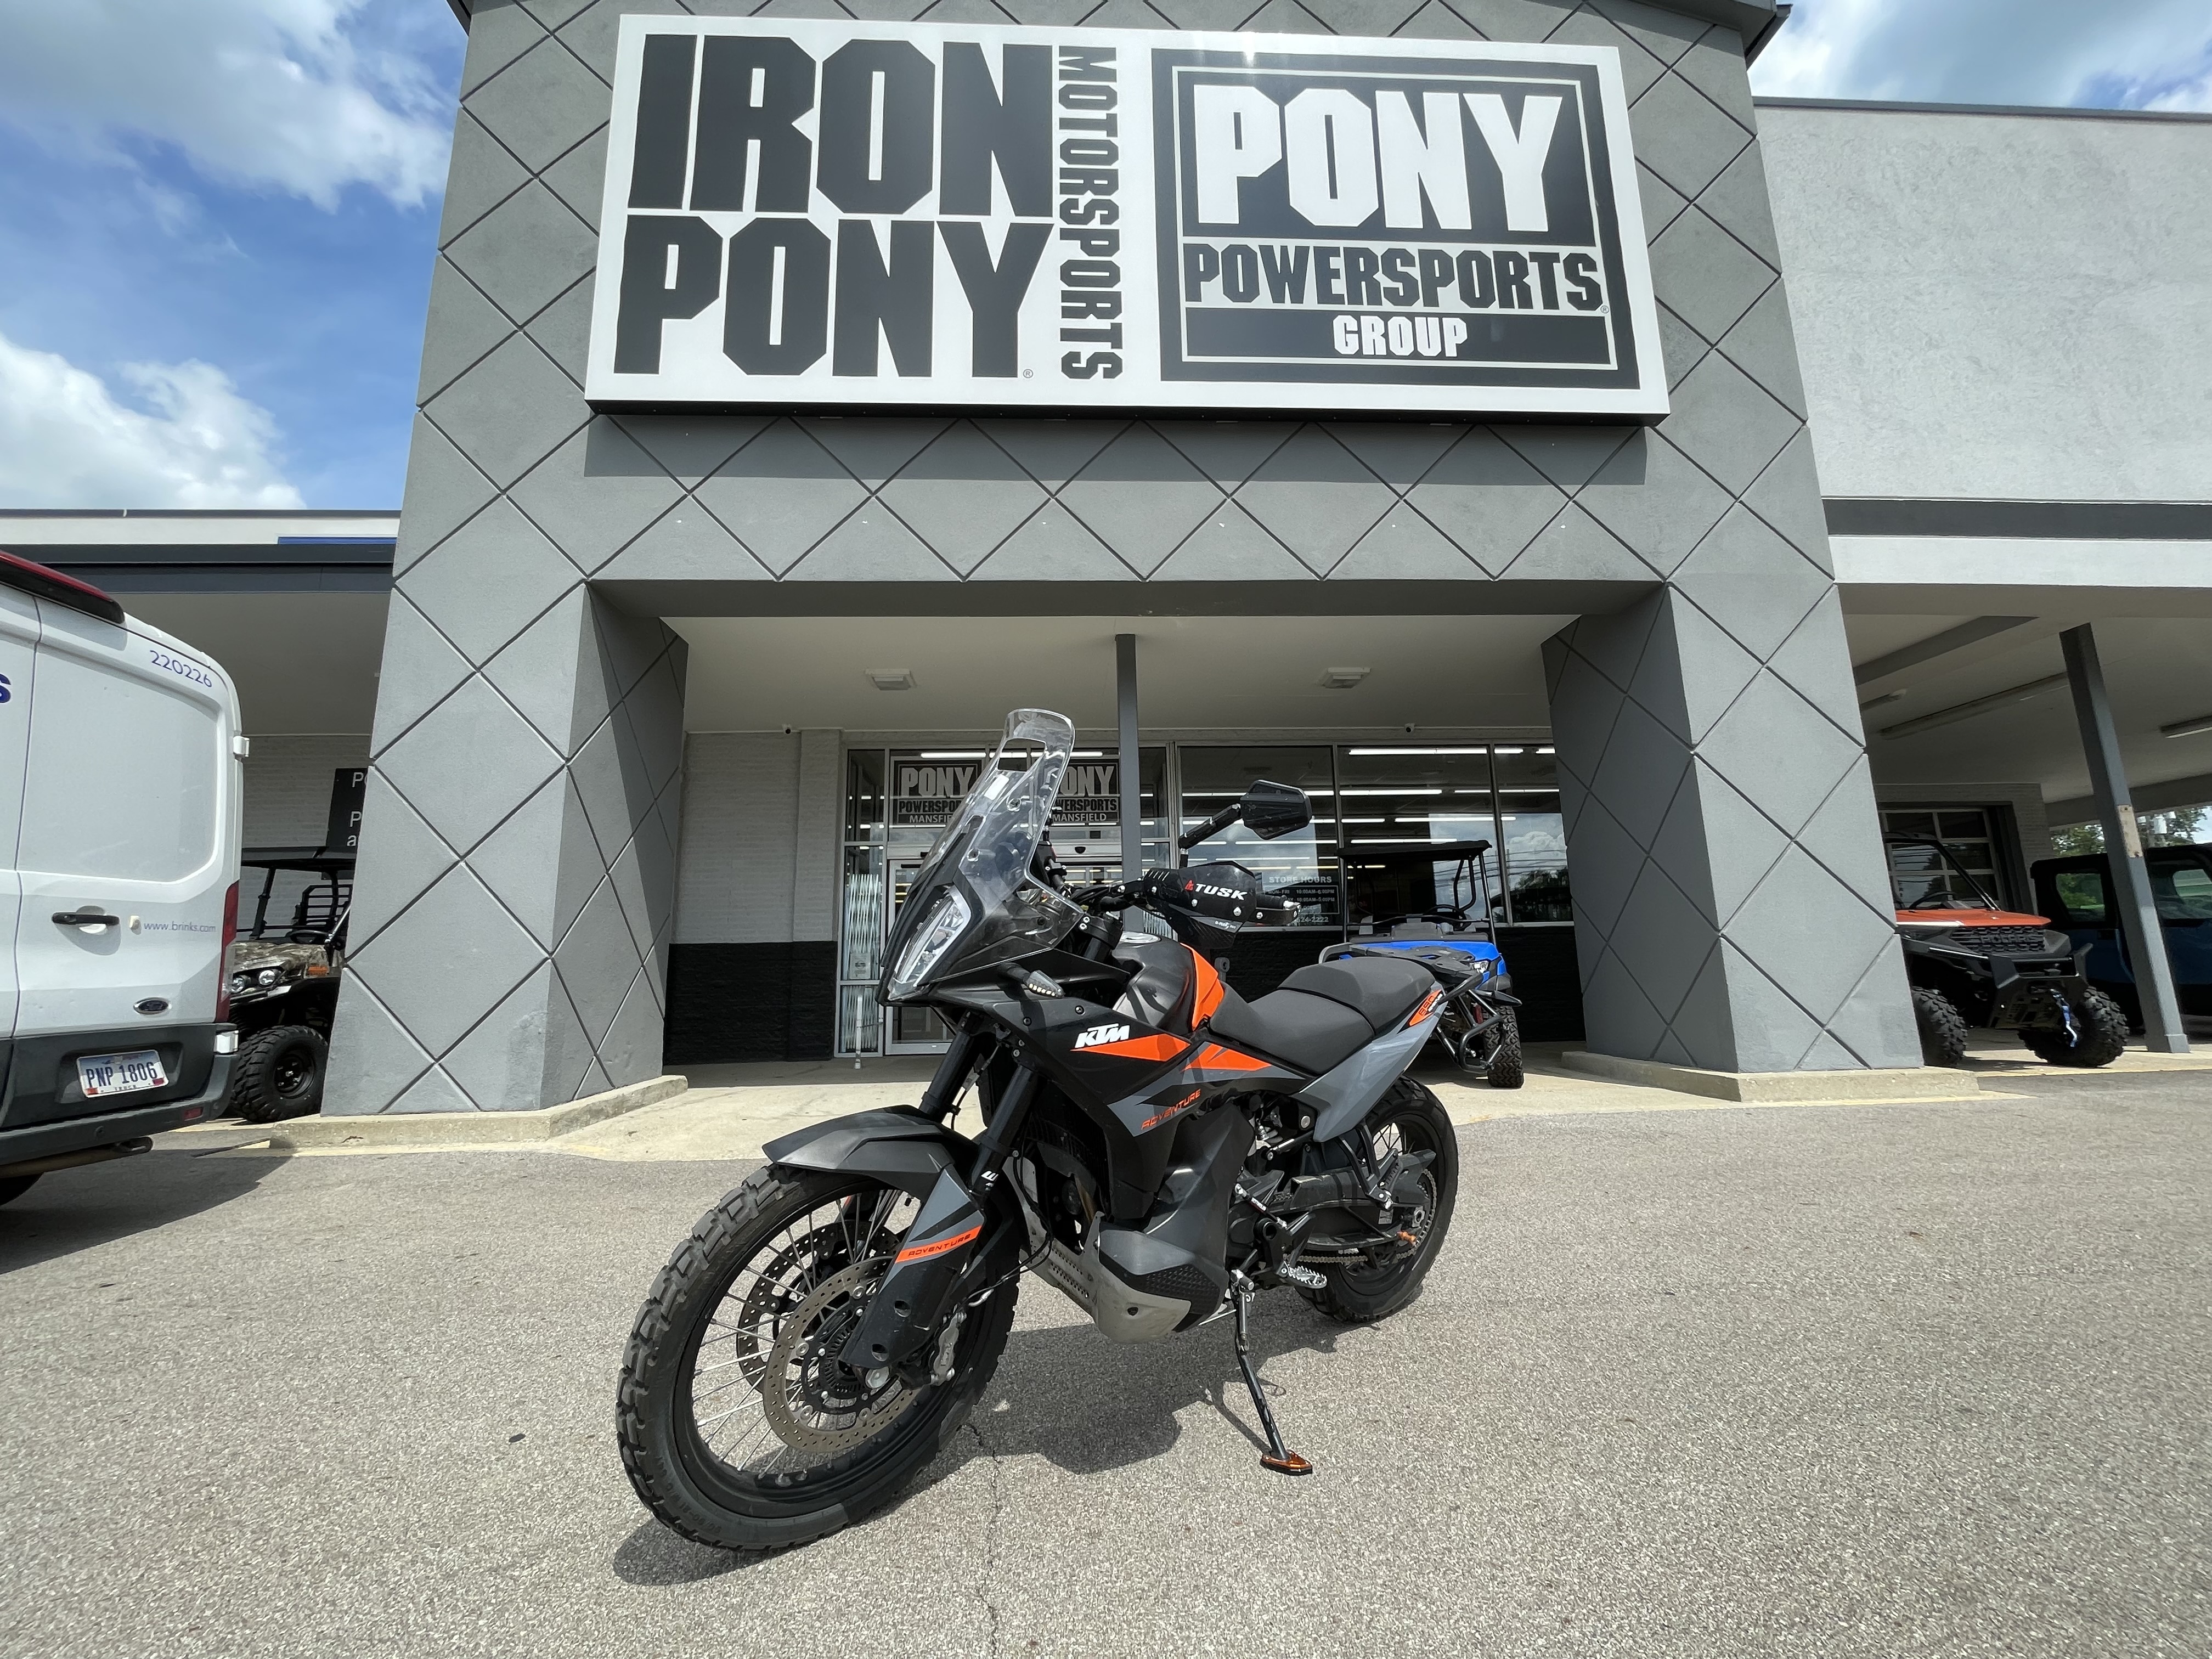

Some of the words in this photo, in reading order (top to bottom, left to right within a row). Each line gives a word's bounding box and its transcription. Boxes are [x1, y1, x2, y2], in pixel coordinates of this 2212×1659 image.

[628, 33, 1053, 217] IRON
[1194, 84, 1562, 232] PONY
[1058, 46, 1123, 380] MOTORSPORTS
[1183, 244, 1604, 312] POWERSPORTS
[613, 215, 1055, 378] PONY
[1333, 315, 1468, 357] GROUP
[150, 650, 212, 687] 220226
[901, 767, 974, 797] PONY
[1056, 766, 1115, 797] ONY
[910, 815, 952, 823] MANSFIE
[1053, 813, 1107, 822] MANSFIELD
[1195, 883, 1248, 900] TUSK
[144, 921, 216, 933] www.brinks.com
[1075, 1023, 1130, 1048] KTM
[86, 1067, 113, 1088] PNP
[119, 1062, 157, 1084] 1806
[1141, 1088, 1201, 1130] ADVENTURE
[908, 1234, 971, 1257] ADVENTURE
